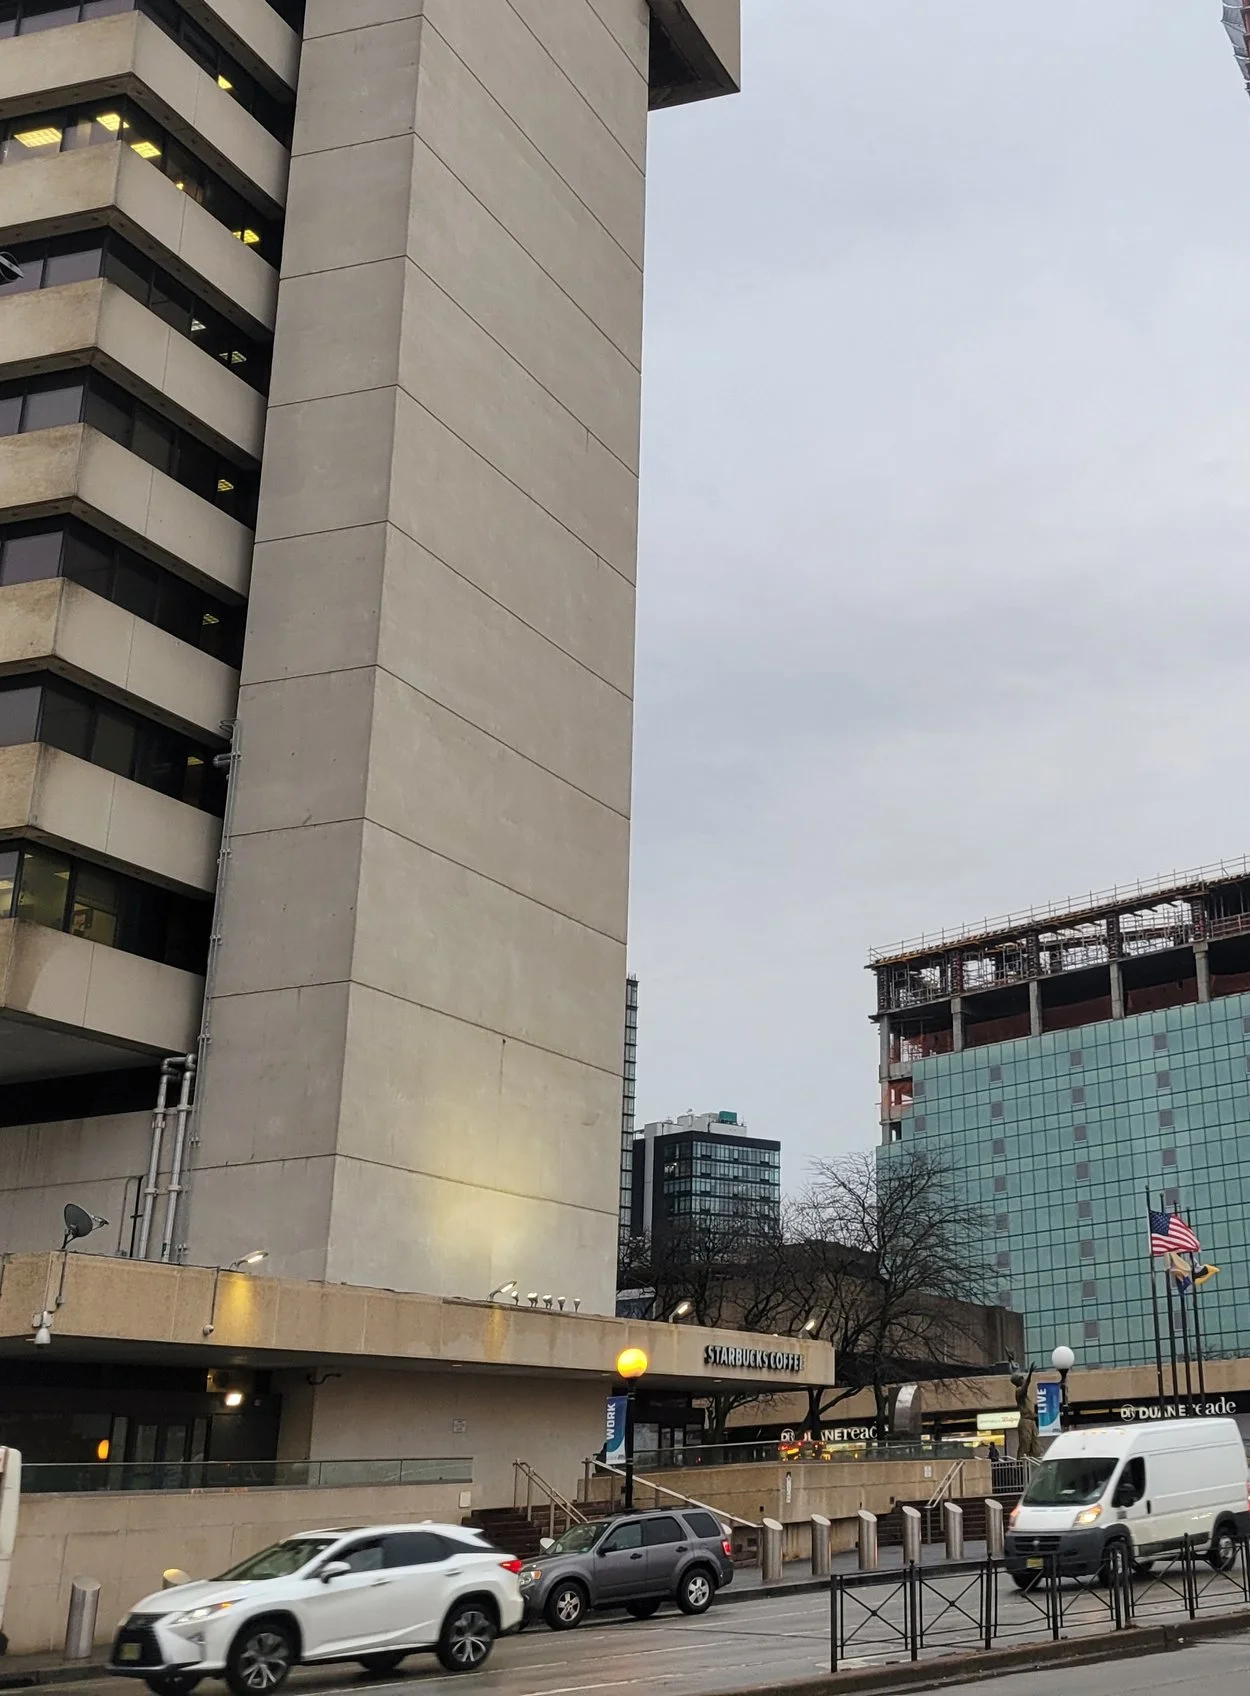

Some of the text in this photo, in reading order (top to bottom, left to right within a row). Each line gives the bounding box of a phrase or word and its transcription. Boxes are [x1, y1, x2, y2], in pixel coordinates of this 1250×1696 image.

[705, 1345, 804, 1371] STARBUCKS COFFEE
[1036, 1387, 1047, 1414] LIVE
[606, 1402, 616, 1440] WORK
